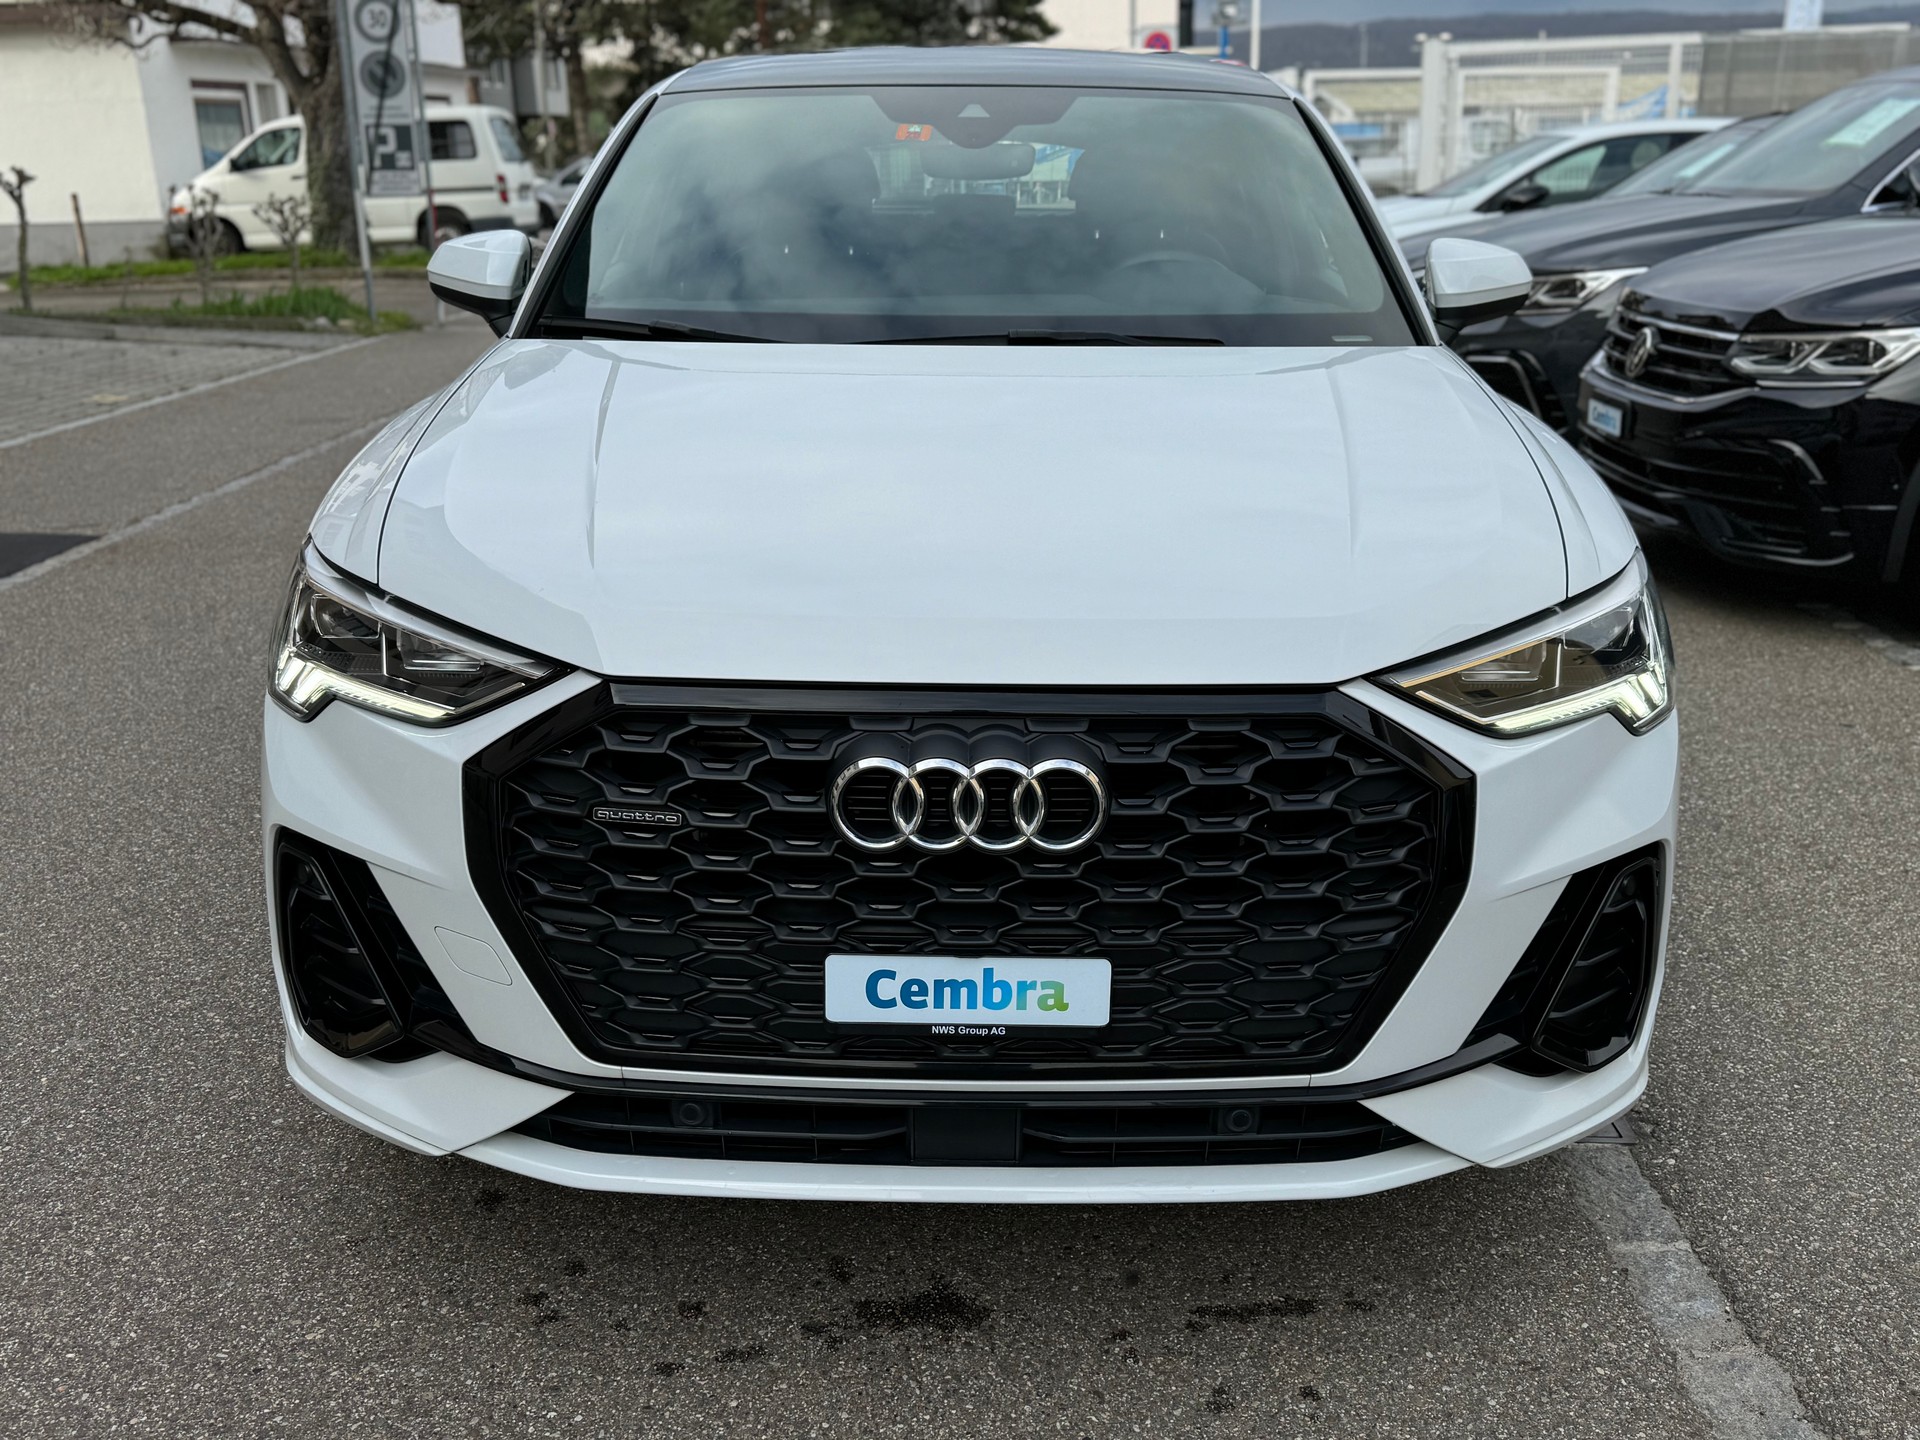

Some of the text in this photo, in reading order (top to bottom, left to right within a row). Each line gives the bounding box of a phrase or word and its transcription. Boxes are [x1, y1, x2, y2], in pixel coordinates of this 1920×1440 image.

[368, 8, 388, 29] 30
[597, 810, 678, 822] quattro
[865, 967, 1069, 1012] Cembra
[931, 1025, 1006, 1037] NWS Group AG
